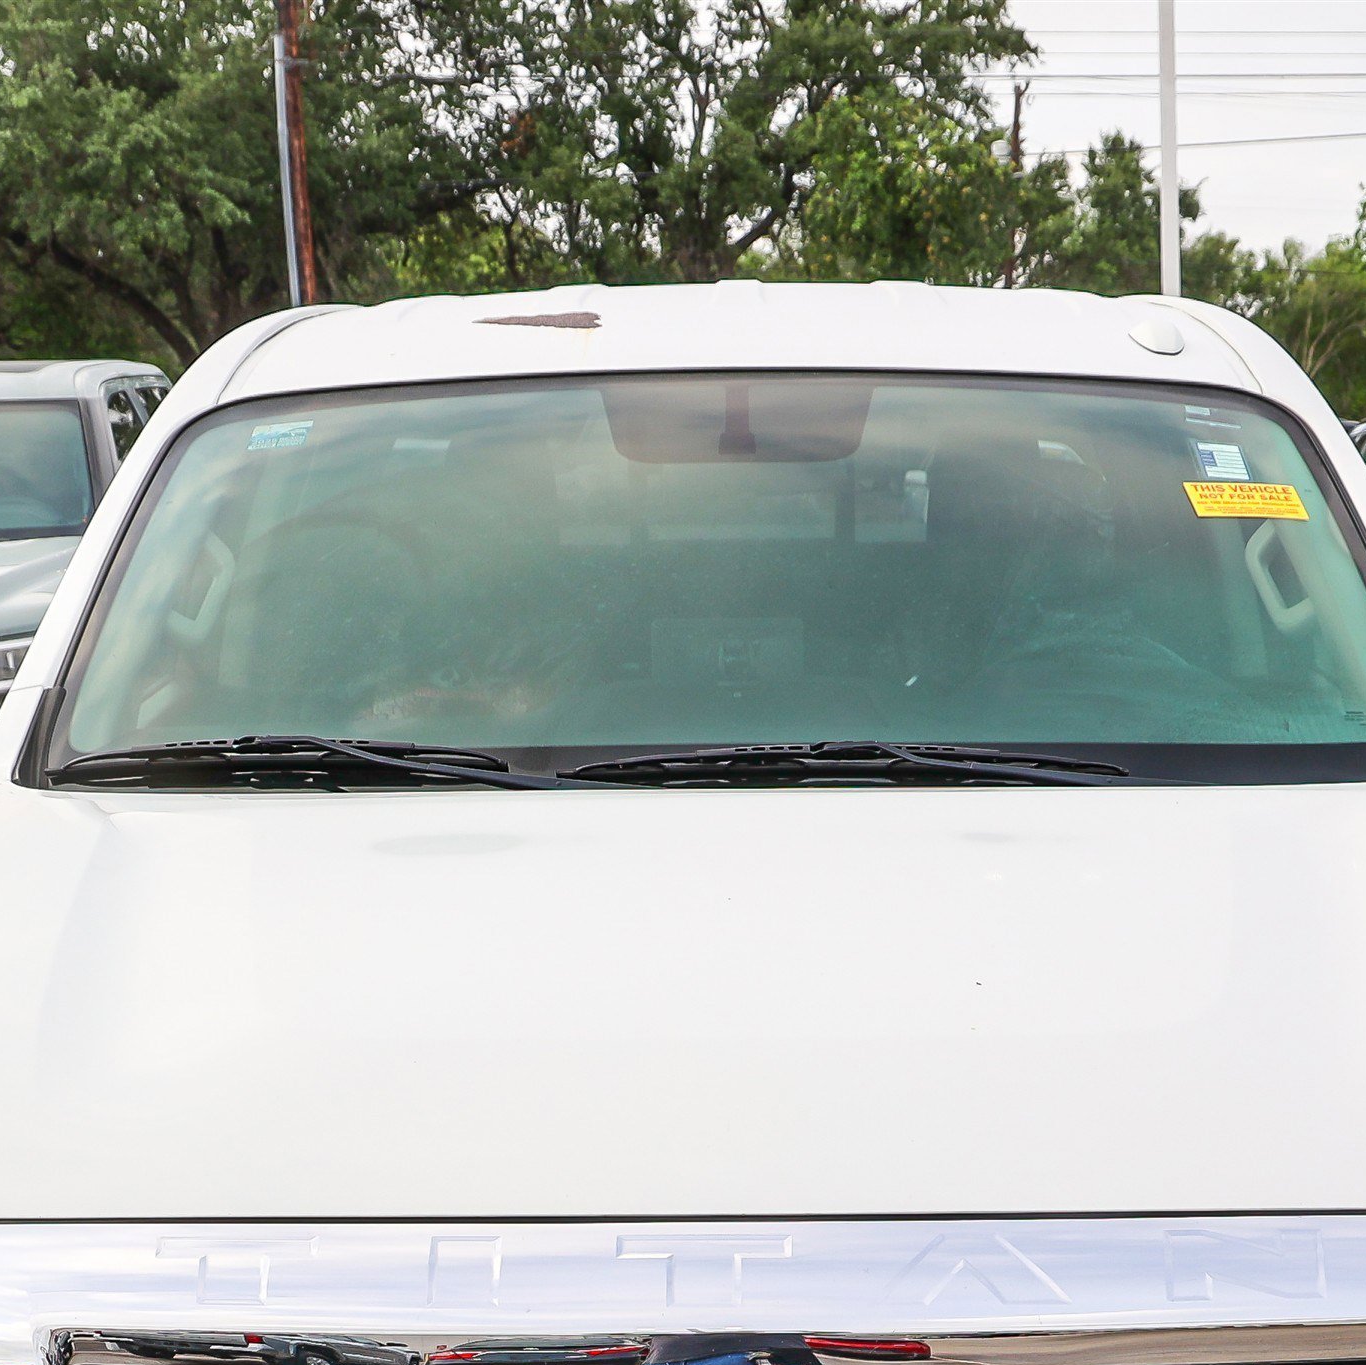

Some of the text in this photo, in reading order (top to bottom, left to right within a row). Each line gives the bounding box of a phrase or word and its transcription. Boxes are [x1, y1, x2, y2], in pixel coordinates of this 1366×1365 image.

[1190, 484, 1292, 495] THIS VEHICLE
[155, 1229, 1327, 1305] TITAN
